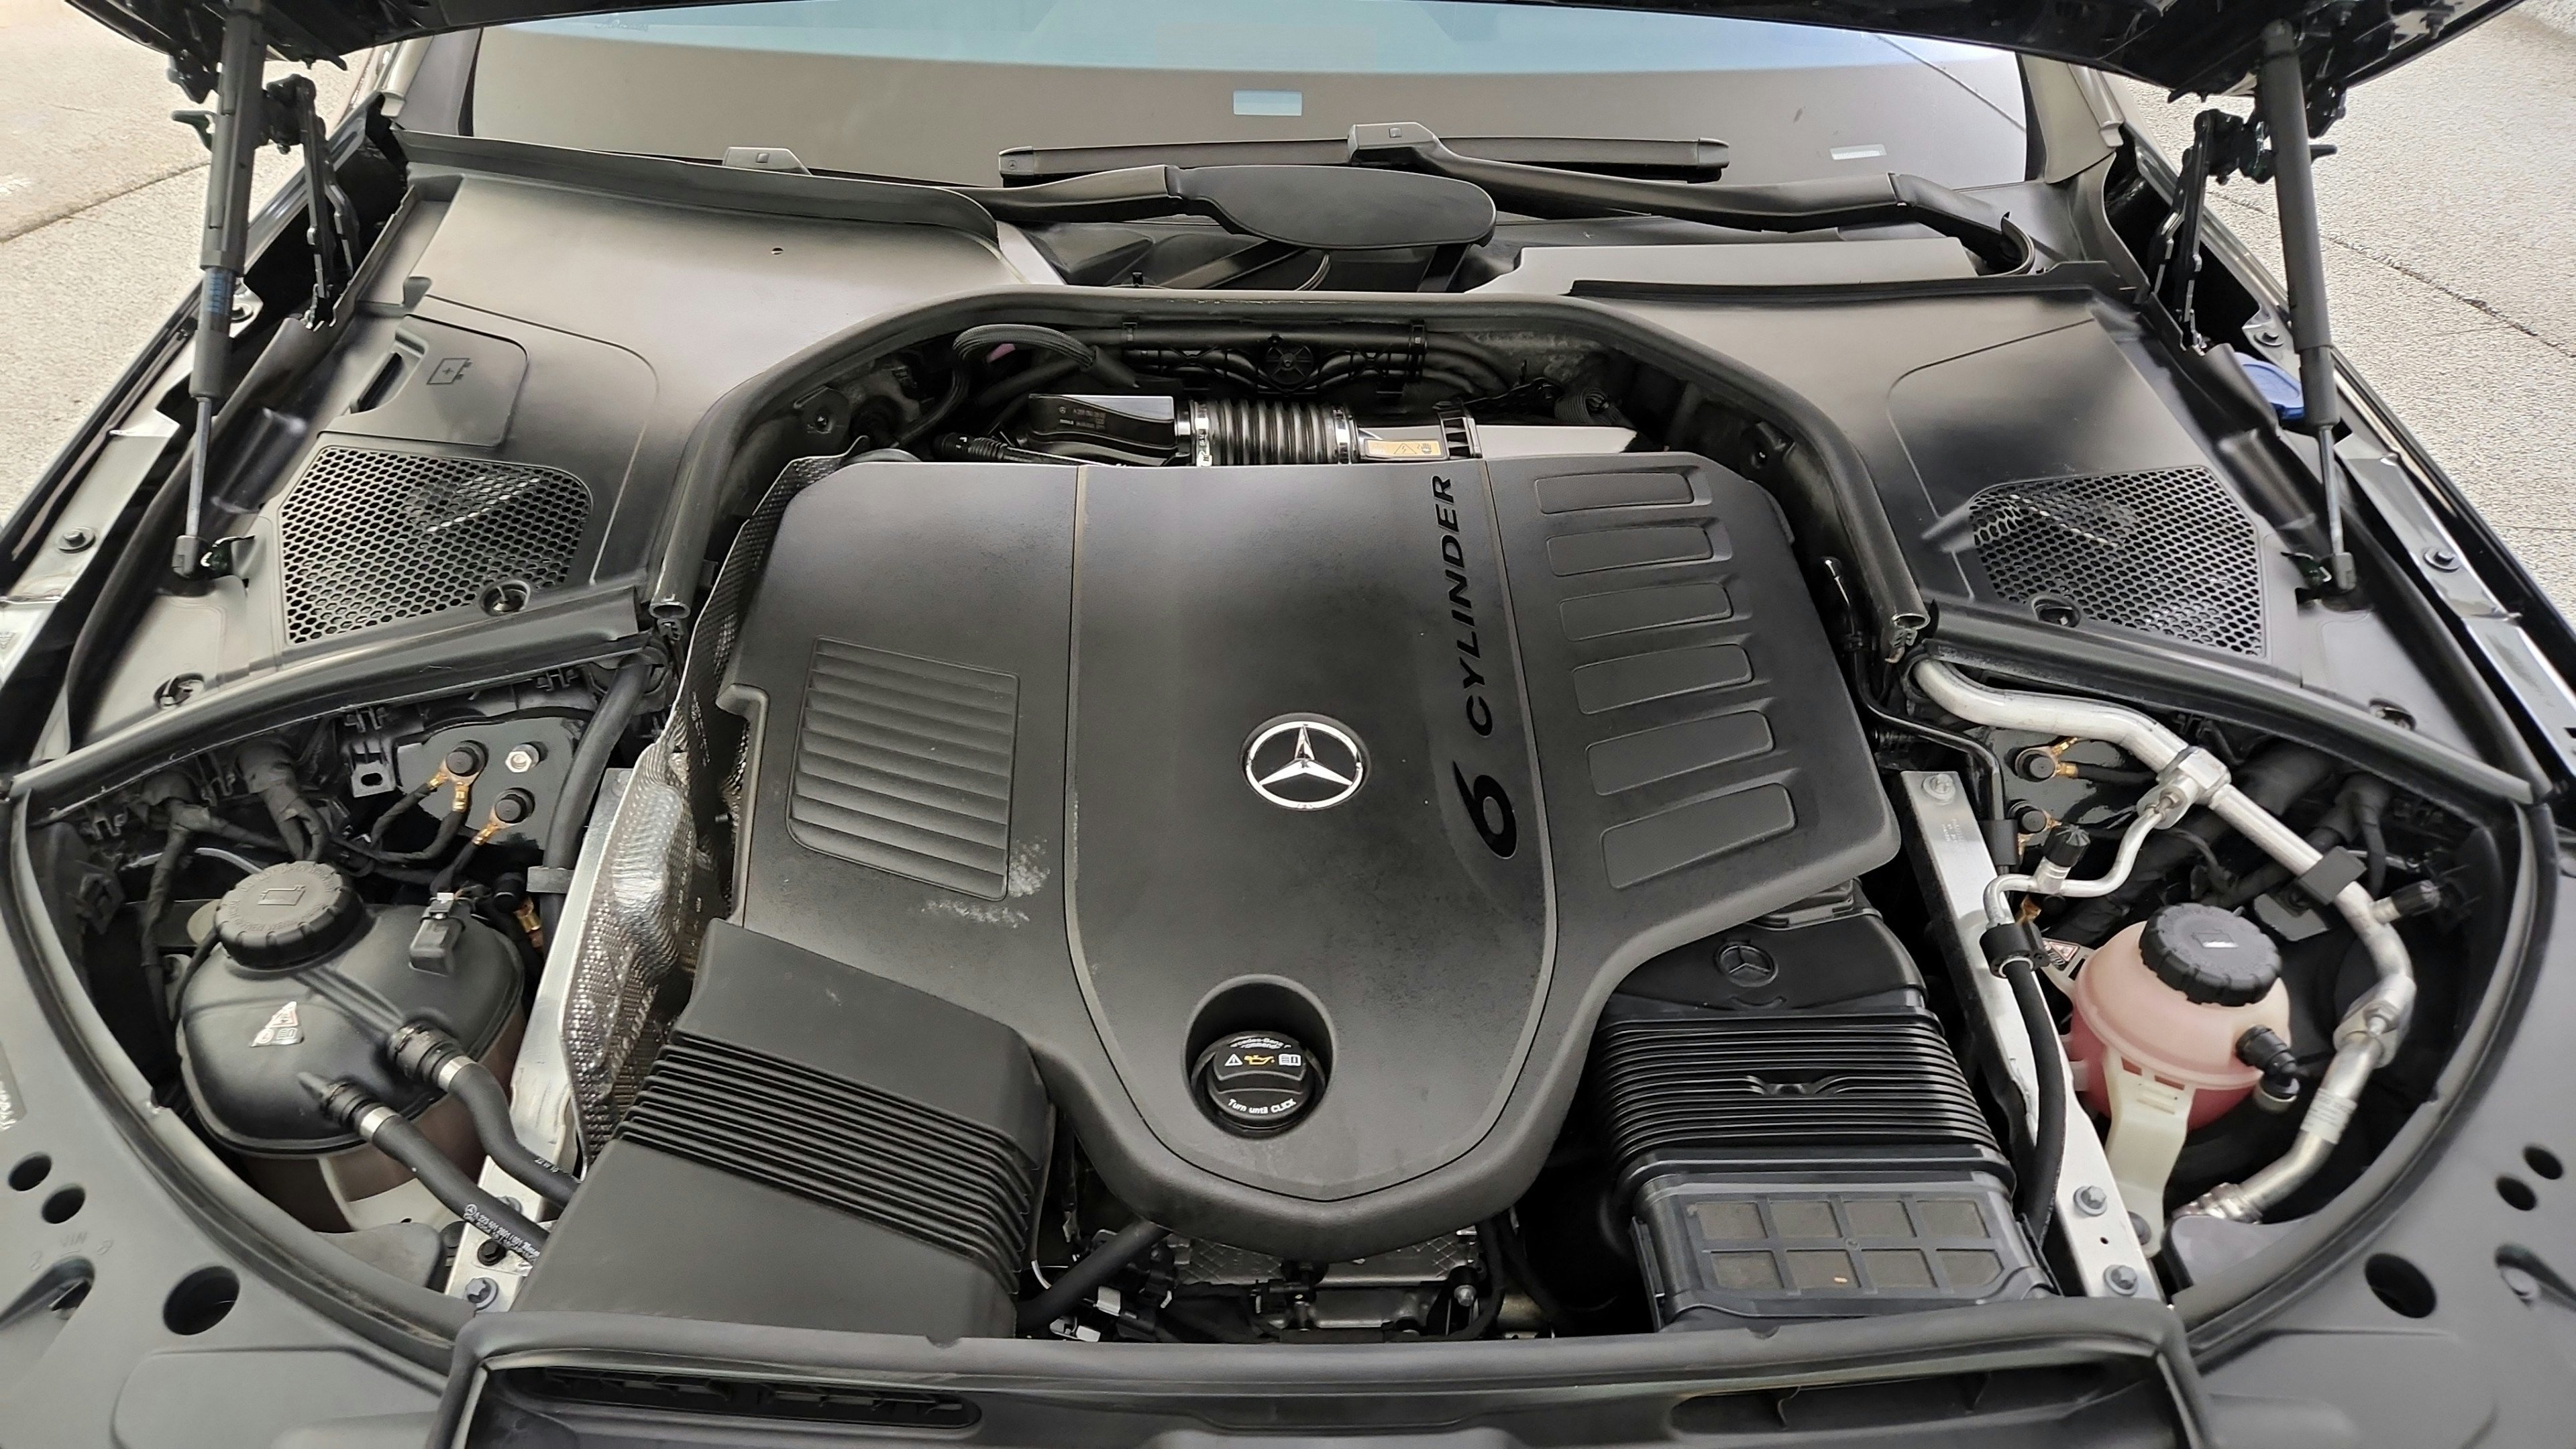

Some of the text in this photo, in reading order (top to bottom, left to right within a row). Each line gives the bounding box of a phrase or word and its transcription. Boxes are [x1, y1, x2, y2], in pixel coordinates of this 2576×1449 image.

[1431, 474, 1517, 859] 6 CYLINDER
[1228, 1097, 1297, 1114] Turn until CLICK
